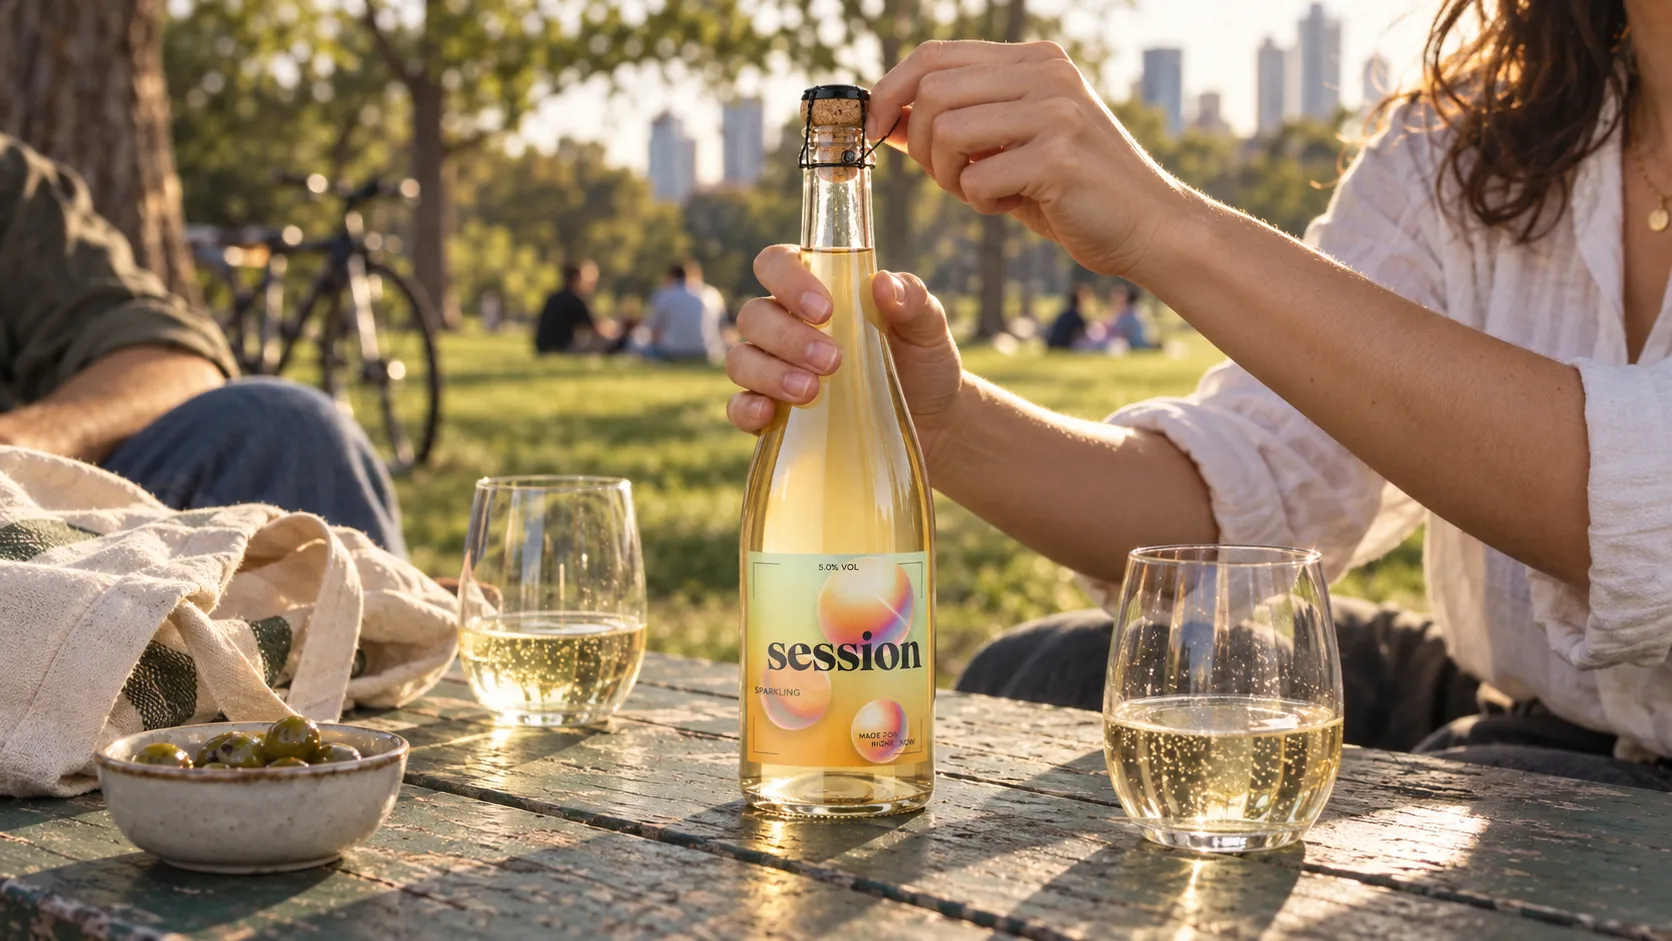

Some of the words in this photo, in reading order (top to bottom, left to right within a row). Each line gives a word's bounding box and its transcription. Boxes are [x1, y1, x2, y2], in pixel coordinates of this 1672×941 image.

[818, 563, 839, 571] 5.0%
[841, 563, 859, 571] VOL
[767, 630, 922, 671] session
[754, 686, 801, 697] SPARKLING
